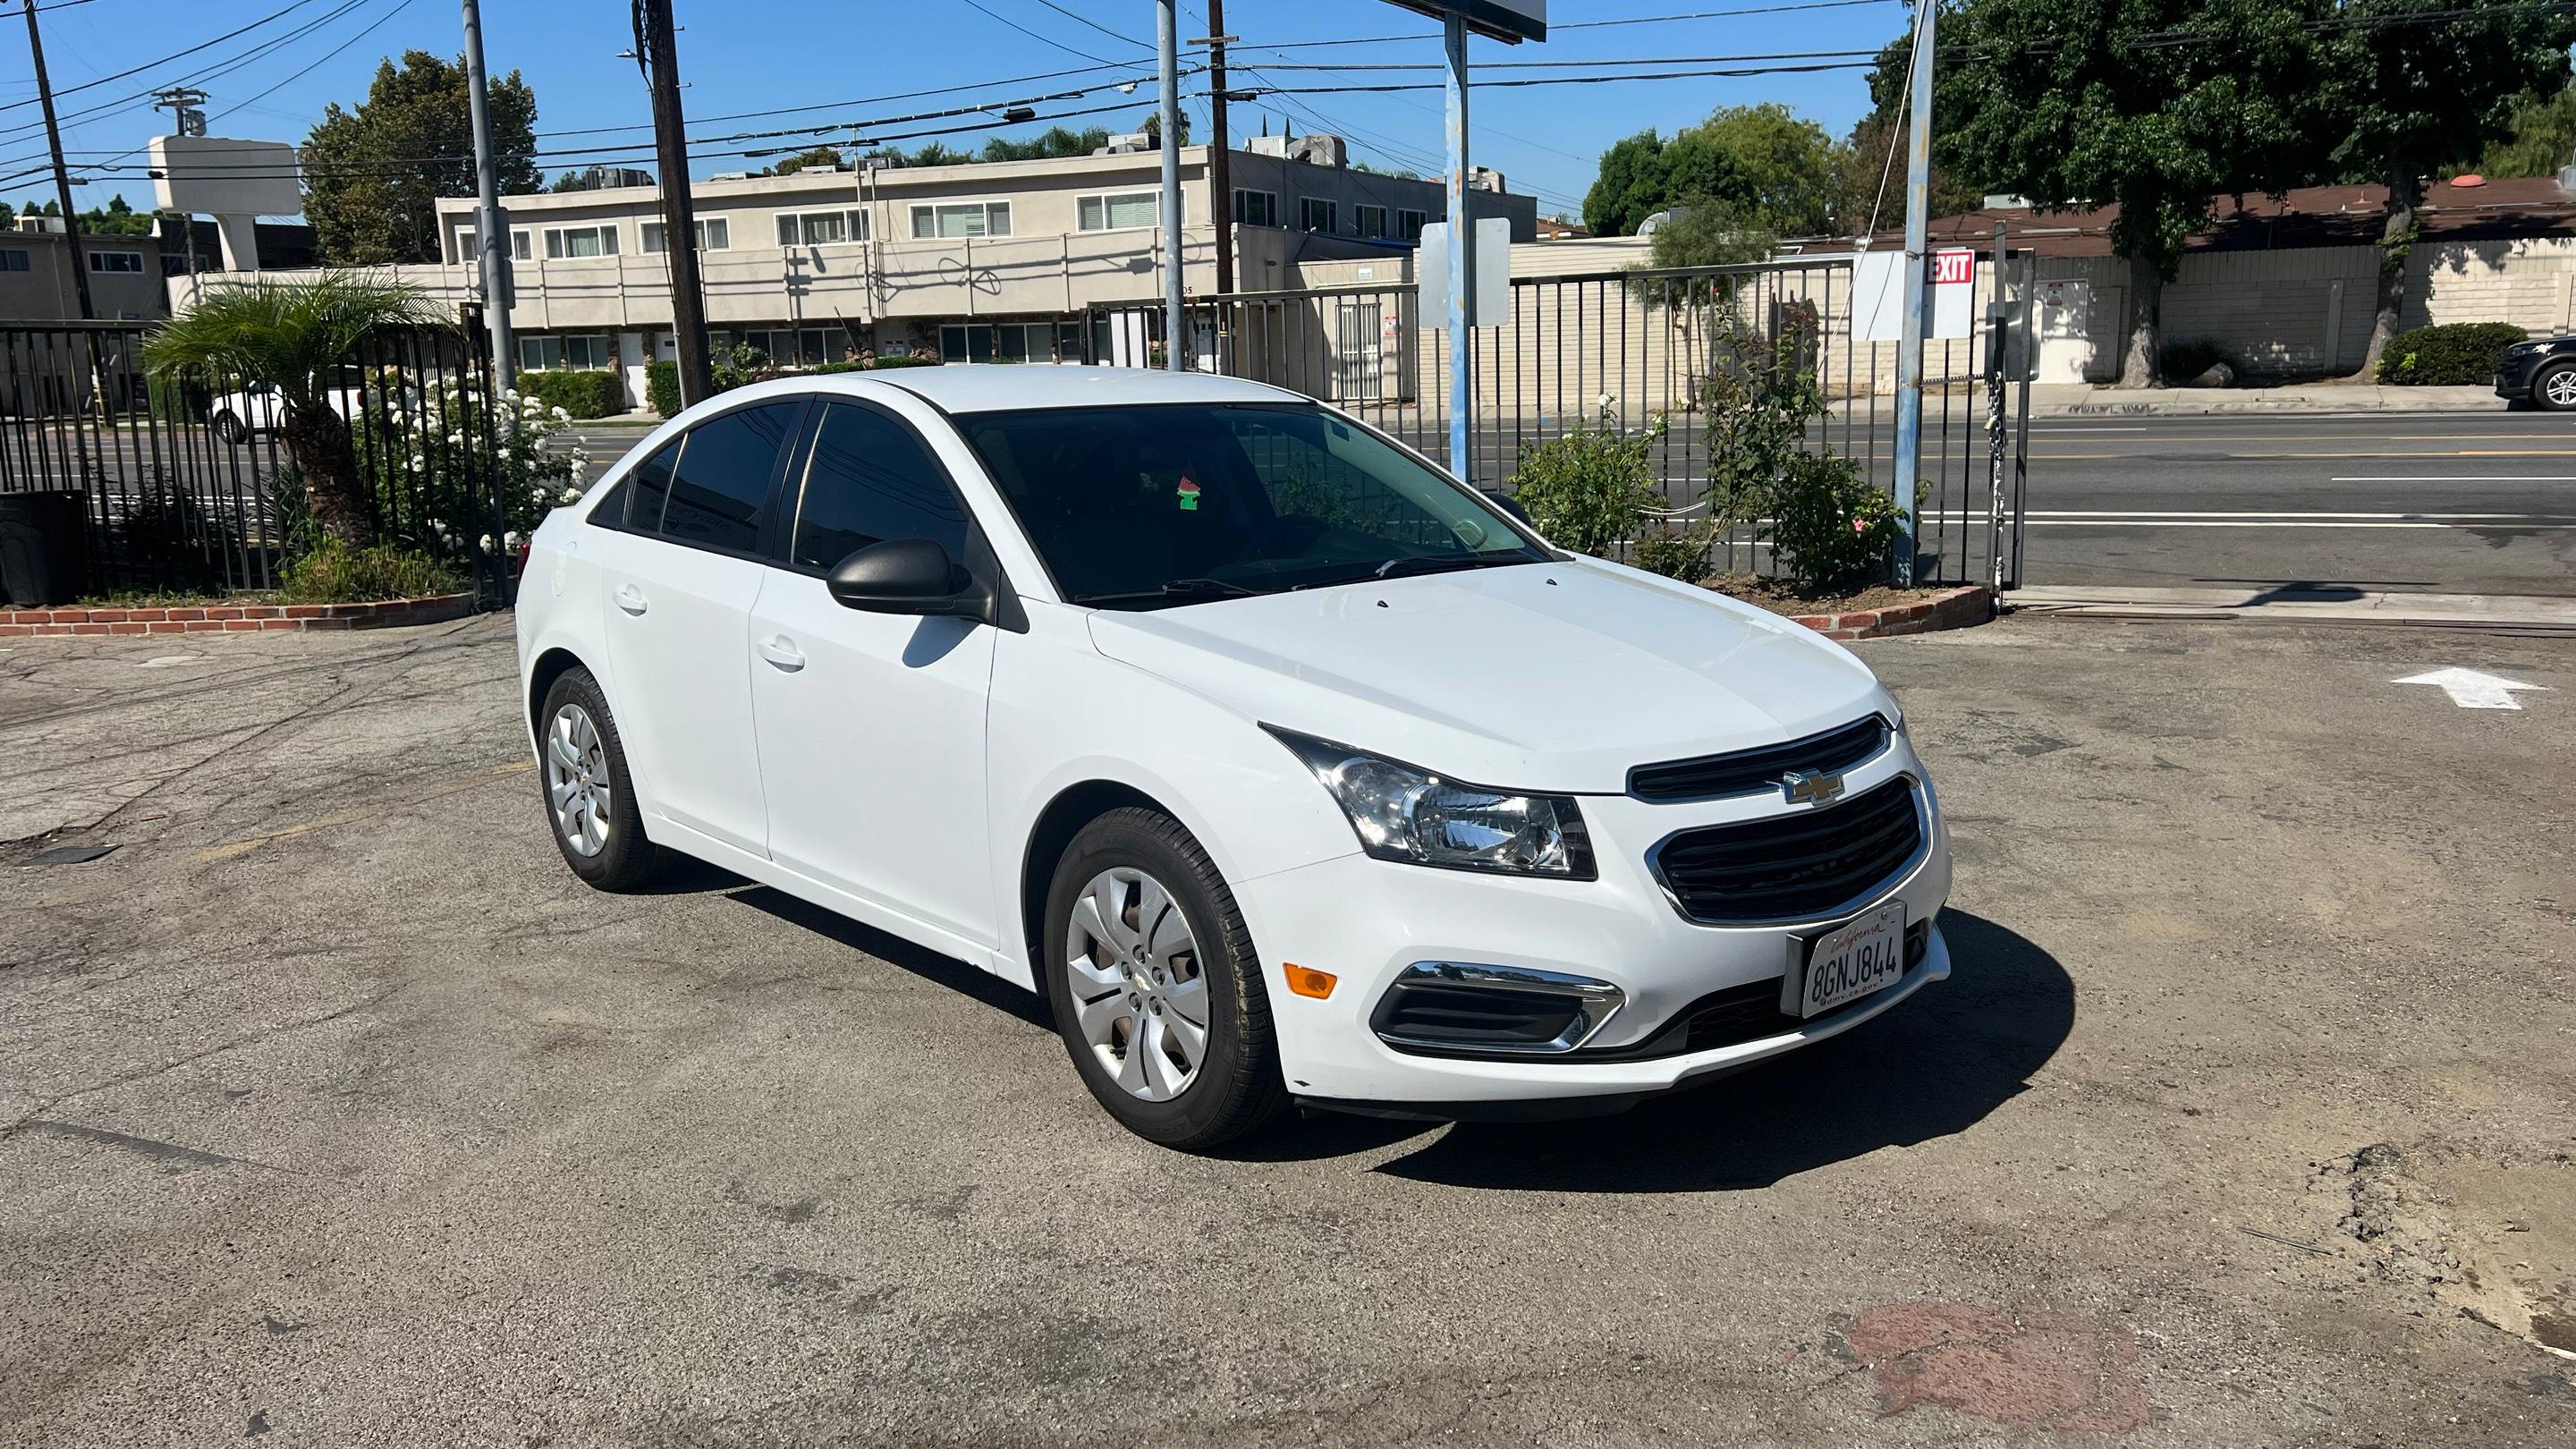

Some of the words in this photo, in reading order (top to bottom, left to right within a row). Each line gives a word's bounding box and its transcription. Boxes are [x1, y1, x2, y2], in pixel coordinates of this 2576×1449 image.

[1928, 255, 1970, 282] EXIT
[1831, 924, 1885, 953] California
[1812, 936, 1896, 1002] 8GNJ844
